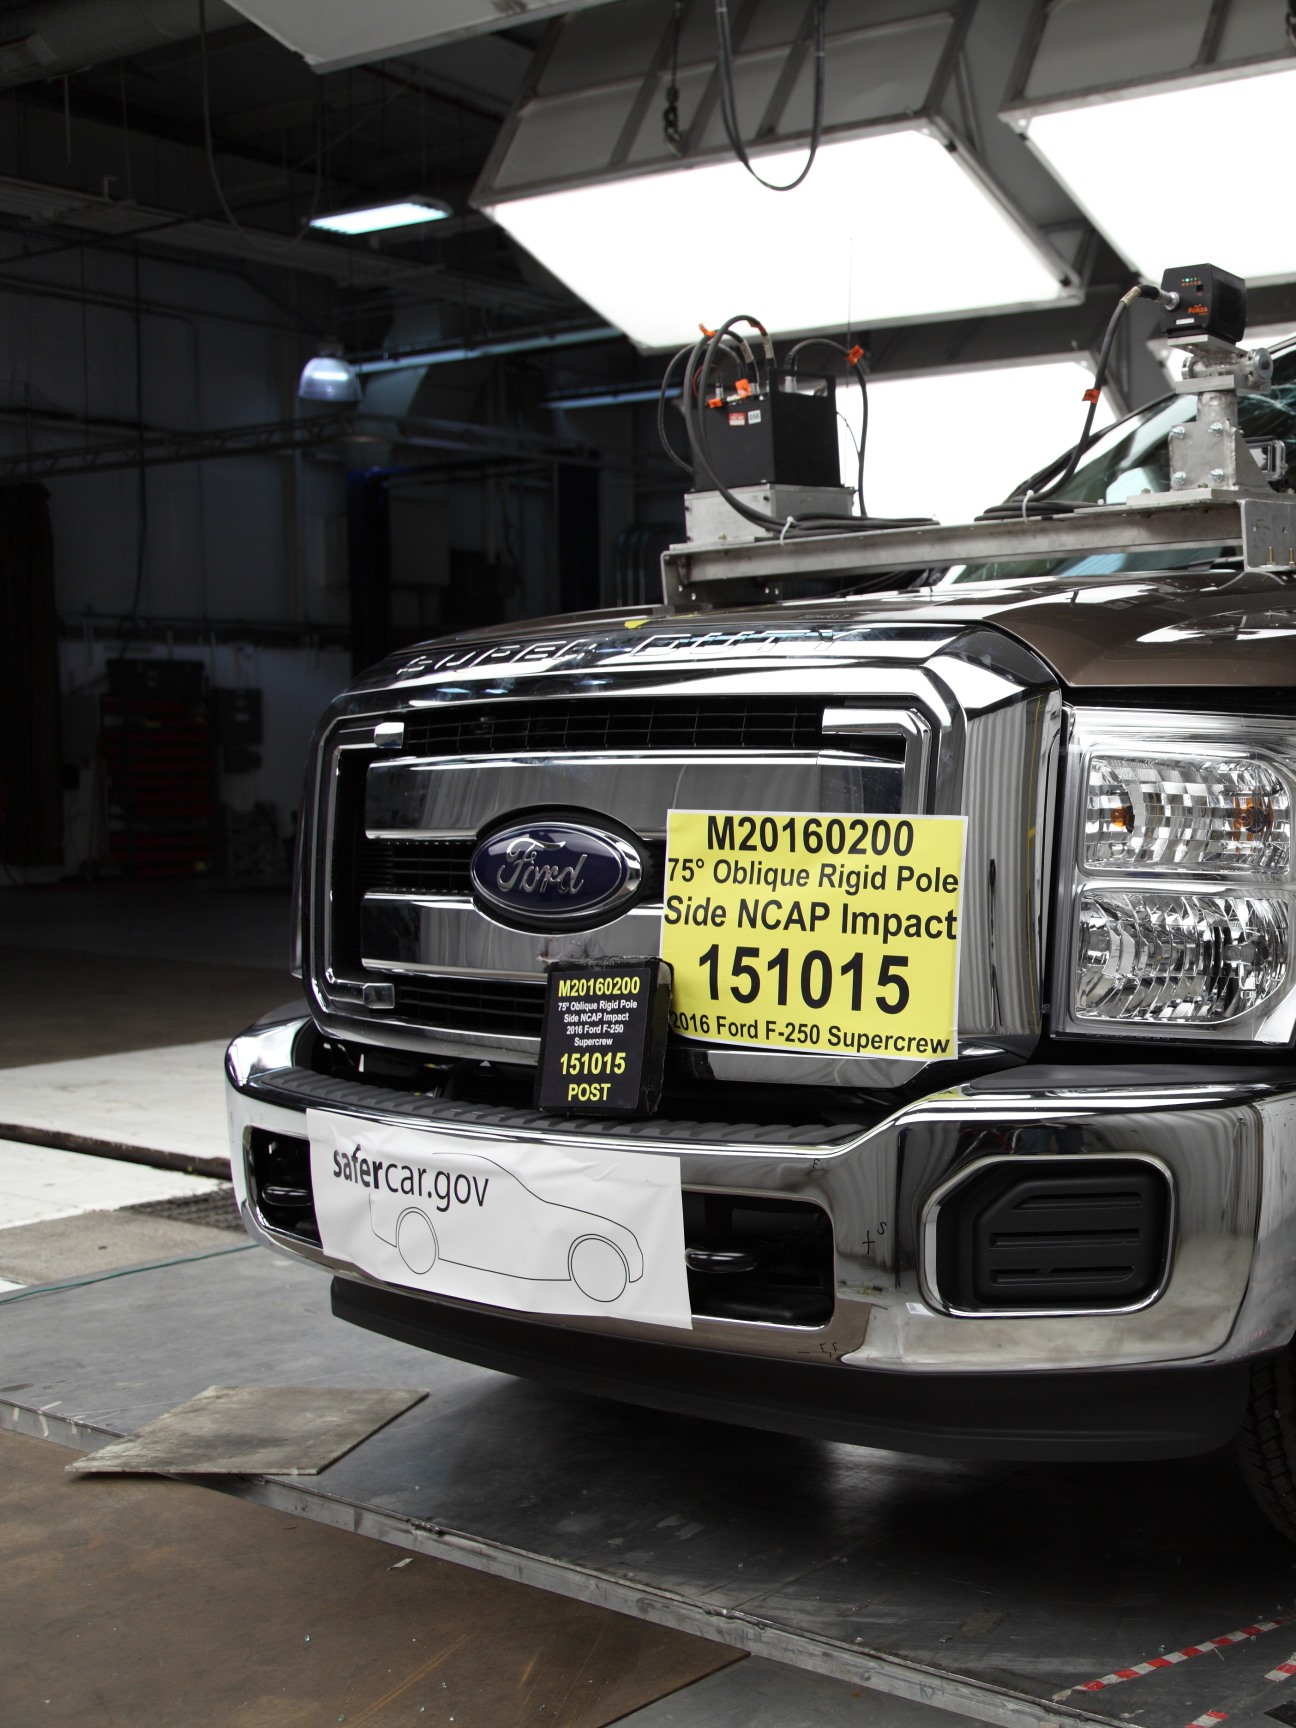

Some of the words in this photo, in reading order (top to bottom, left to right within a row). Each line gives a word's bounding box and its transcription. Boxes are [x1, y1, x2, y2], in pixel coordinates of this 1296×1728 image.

[397, 639, 597, 675] SUPER
[630, 629, 871, 657] DUTY
[707, 815, 914, 857] M20160200
[497, 837, 588, 895] Ford
[712, 859, 810, 892] Oblique
[818, 863, 887, 896] Rigid
[897, 866, 959, 893] Pole
[664, 895, 727, 927] Side
[737, 898, 830, 932] NCAP
[841, 903, 958, 944] Impact
[558, 977, 640, 997] M20160200
[699, 943, 910, 1015] 151015
[564, 1014, 579, 1023] Side
[581, 1013, 602, 1022] NCAP
[604, 1012, 629, 1023] Impact
[571, 1001, 598, 1012] Oblique
[600, 1000, 618, 1011] Rigid
[620, 1000, 637, 1009] Pole
[566, 1026, 583, 1035] 2016
[584, 1025, 601, 1034] Ford
[603, 1024, 624, 1033] F-250
[574, 1037, 613, 1047] Supercrew
[670, 1012, 710, 1034] 2016
[716, 1016, 758, 1039] Ford
[765, 1021, 820, 1045] F-250
[828, 1025, 951, 1055] Supercrew
[560, 1052, 626, 1075] 151015
[568, 1083, 611, 1101] POST
[333, 1144, 489, 1212] safercar.gov
